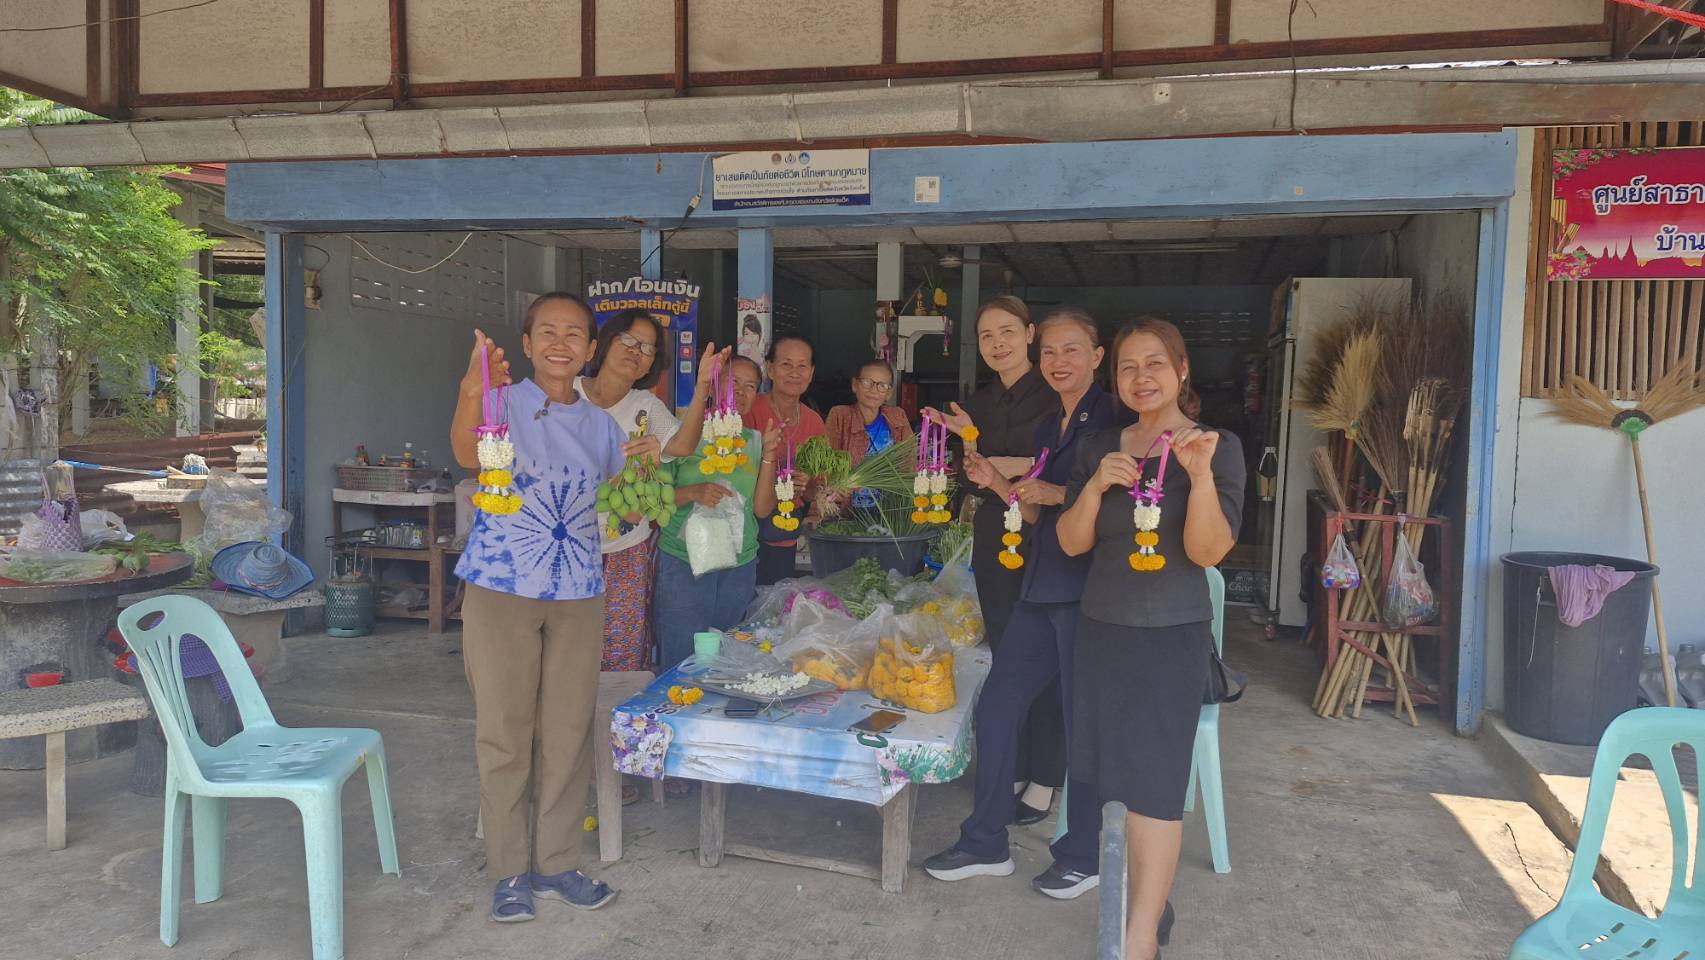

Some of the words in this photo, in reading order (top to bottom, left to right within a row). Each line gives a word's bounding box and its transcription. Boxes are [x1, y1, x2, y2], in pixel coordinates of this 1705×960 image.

[801, 166, 867, 179] มีโทษตามกฎหมาย
[588, 277, 700, 297] ฝาก/โอนเงิน
